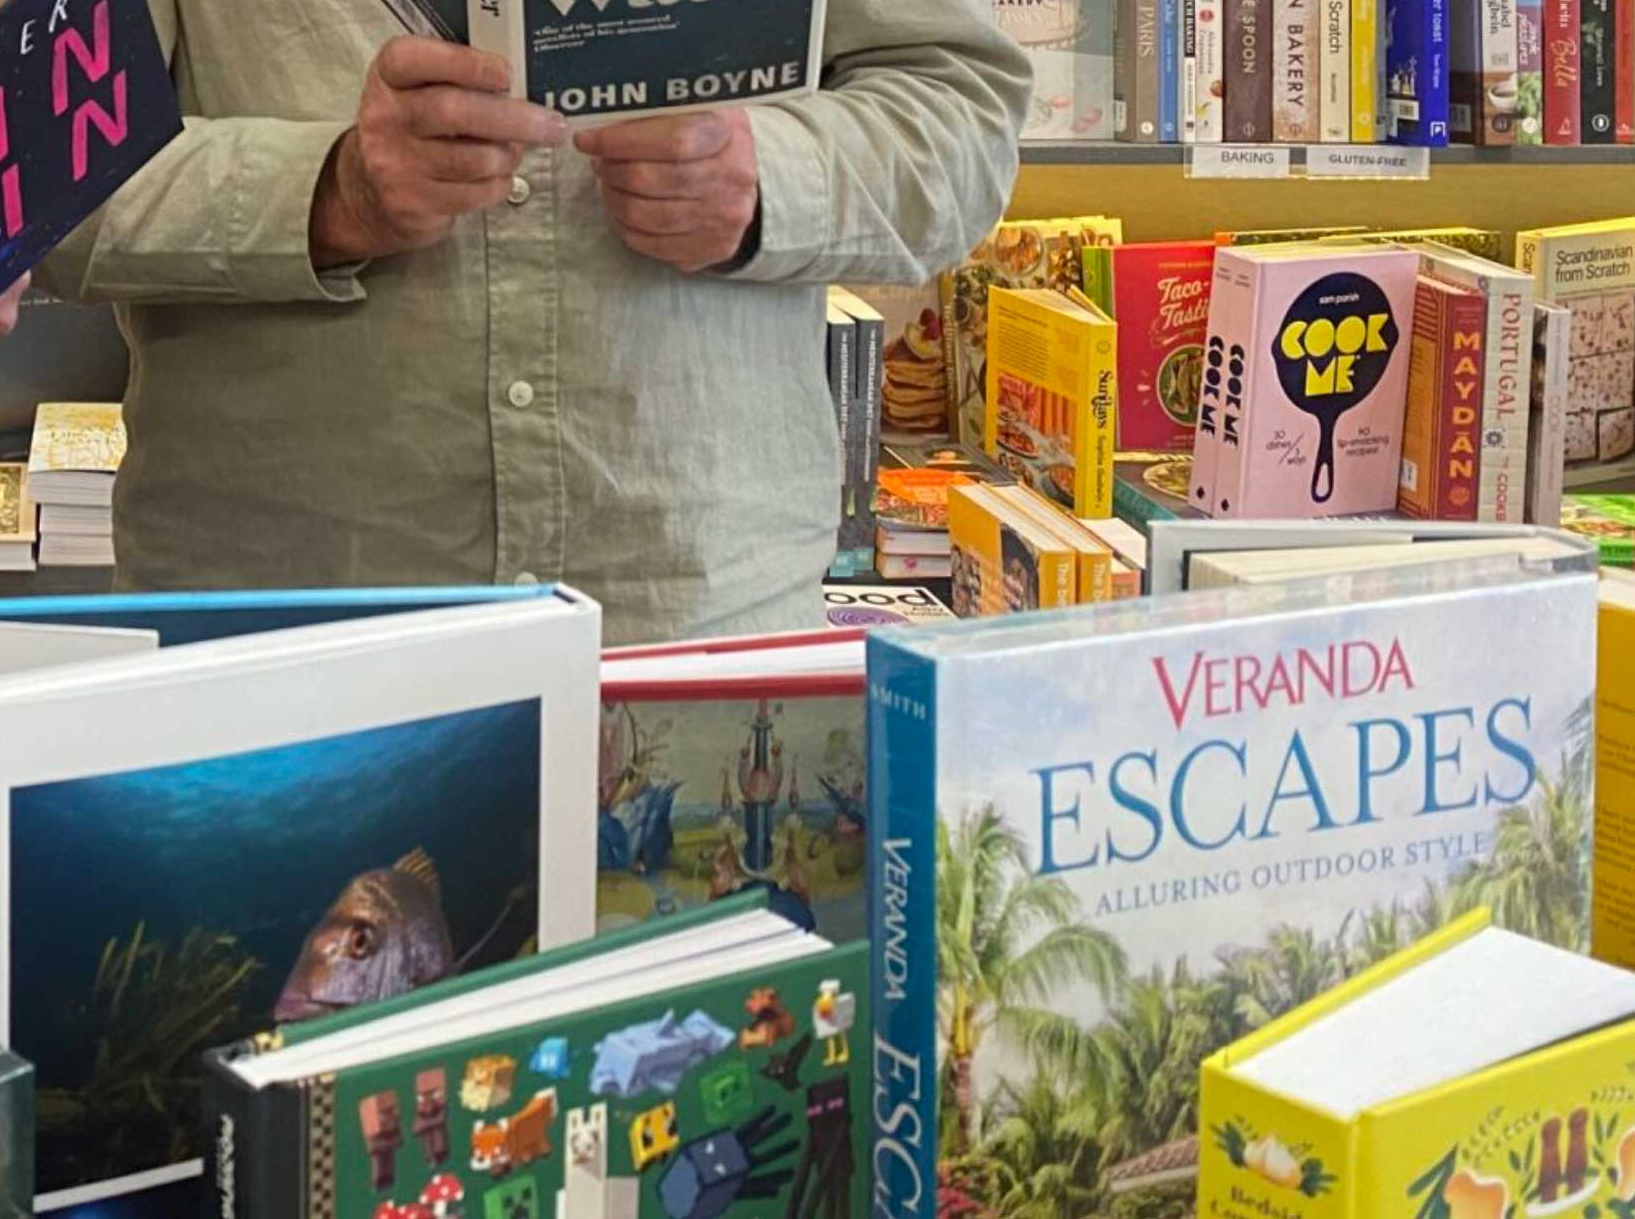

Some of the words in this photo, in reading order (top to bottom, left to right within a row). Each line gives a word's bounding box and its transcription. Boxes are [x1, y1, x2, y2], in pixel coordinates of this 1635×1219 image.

[1139, 7, 1154, 57] PARIS
[1243, 16, 1255, 74] SPOON
[1328, 1, 1343, 53] Scratch
[543, 82, 647, 112] JOHN
[667, 61, 799, 101] BOYNE
[1287, 24, 1304, 107] BAKERY
[1221, 152, 1274, 164] BAKING
[1329, 154, 1407, 166] GLUTEN-FREE
[1555, 268, 1582, 282] from
[1586, 261, 1631, 280] Scratch
[1556, 246, 1633, 266] Scandinavian
[1157, 277, 1208, 305] Taco-
[1318, 294, 1335, 304] sam
[1337, 293, 1359, 306] parish
[1280, 314, 1388, 360] COOK
[1497, 293, 1521, 421] PORTUGAL
[1204, 336, 1224, 401] COOK
[1226, 344, 1245, 410] COOK
[1304, 358, 1355, 396] ME
[1091, 370, 1113, 429] Sundays
[1200, 407, 1218, 436] ME
[1224, 415, 1239, 447] ME
[1150, 636, 1415, 731] VERANDA
[1028, 696, 1539, 876] ESCAPES
[1093, 871, 1241, 917] ALLURING
[1252, 845, 1396, 890] OUTDOOR
[1405, 832, 1487, 864] STYLE
[881, 837, 913, 1002] VERANDA
